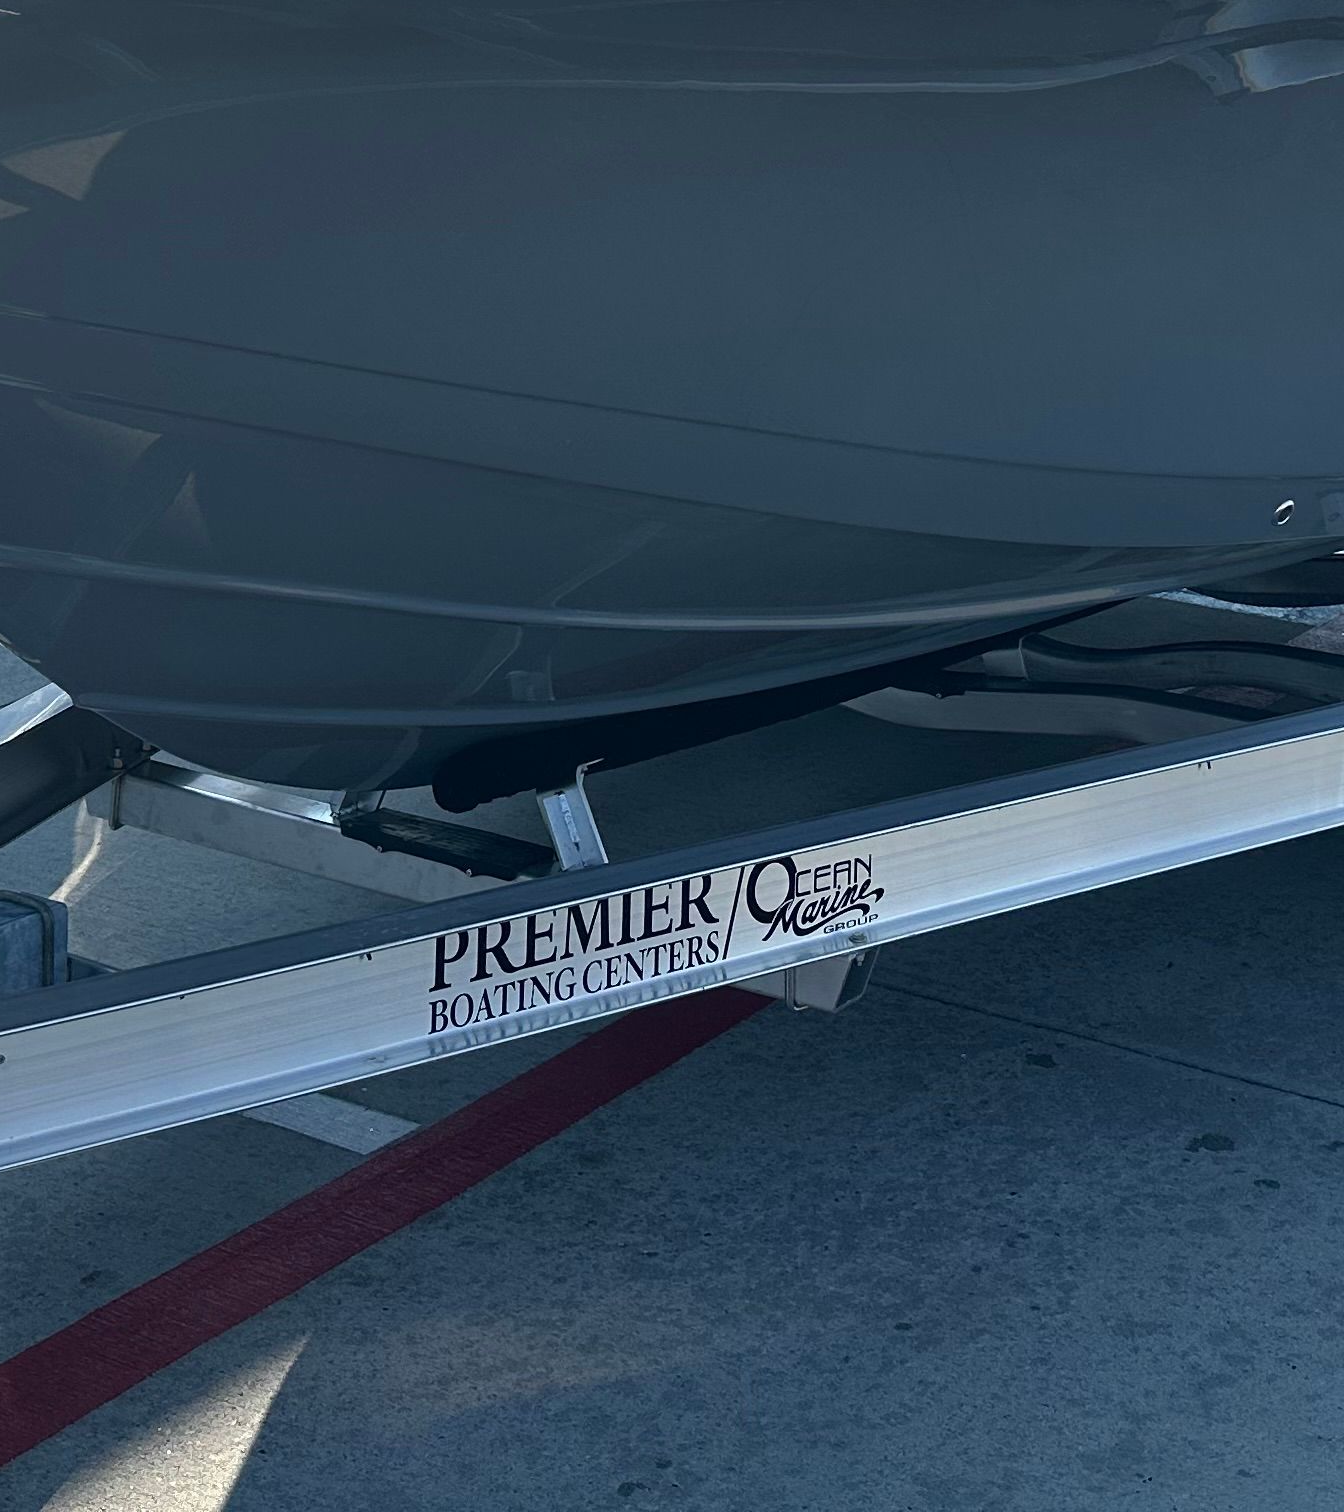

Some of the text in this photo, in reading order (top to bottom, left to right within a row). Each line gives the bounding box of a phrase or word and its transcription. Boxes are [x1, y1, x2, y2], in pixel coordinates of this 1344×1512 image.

[746, 854, 872, 924] OCEAN
[762, 878, 885, 942] Marine
[823, 913, 879, 934] GROUP
[428, 873, 720, 993] PREMIER
[428, 930, 720, 1035] BOATING CENTERS
